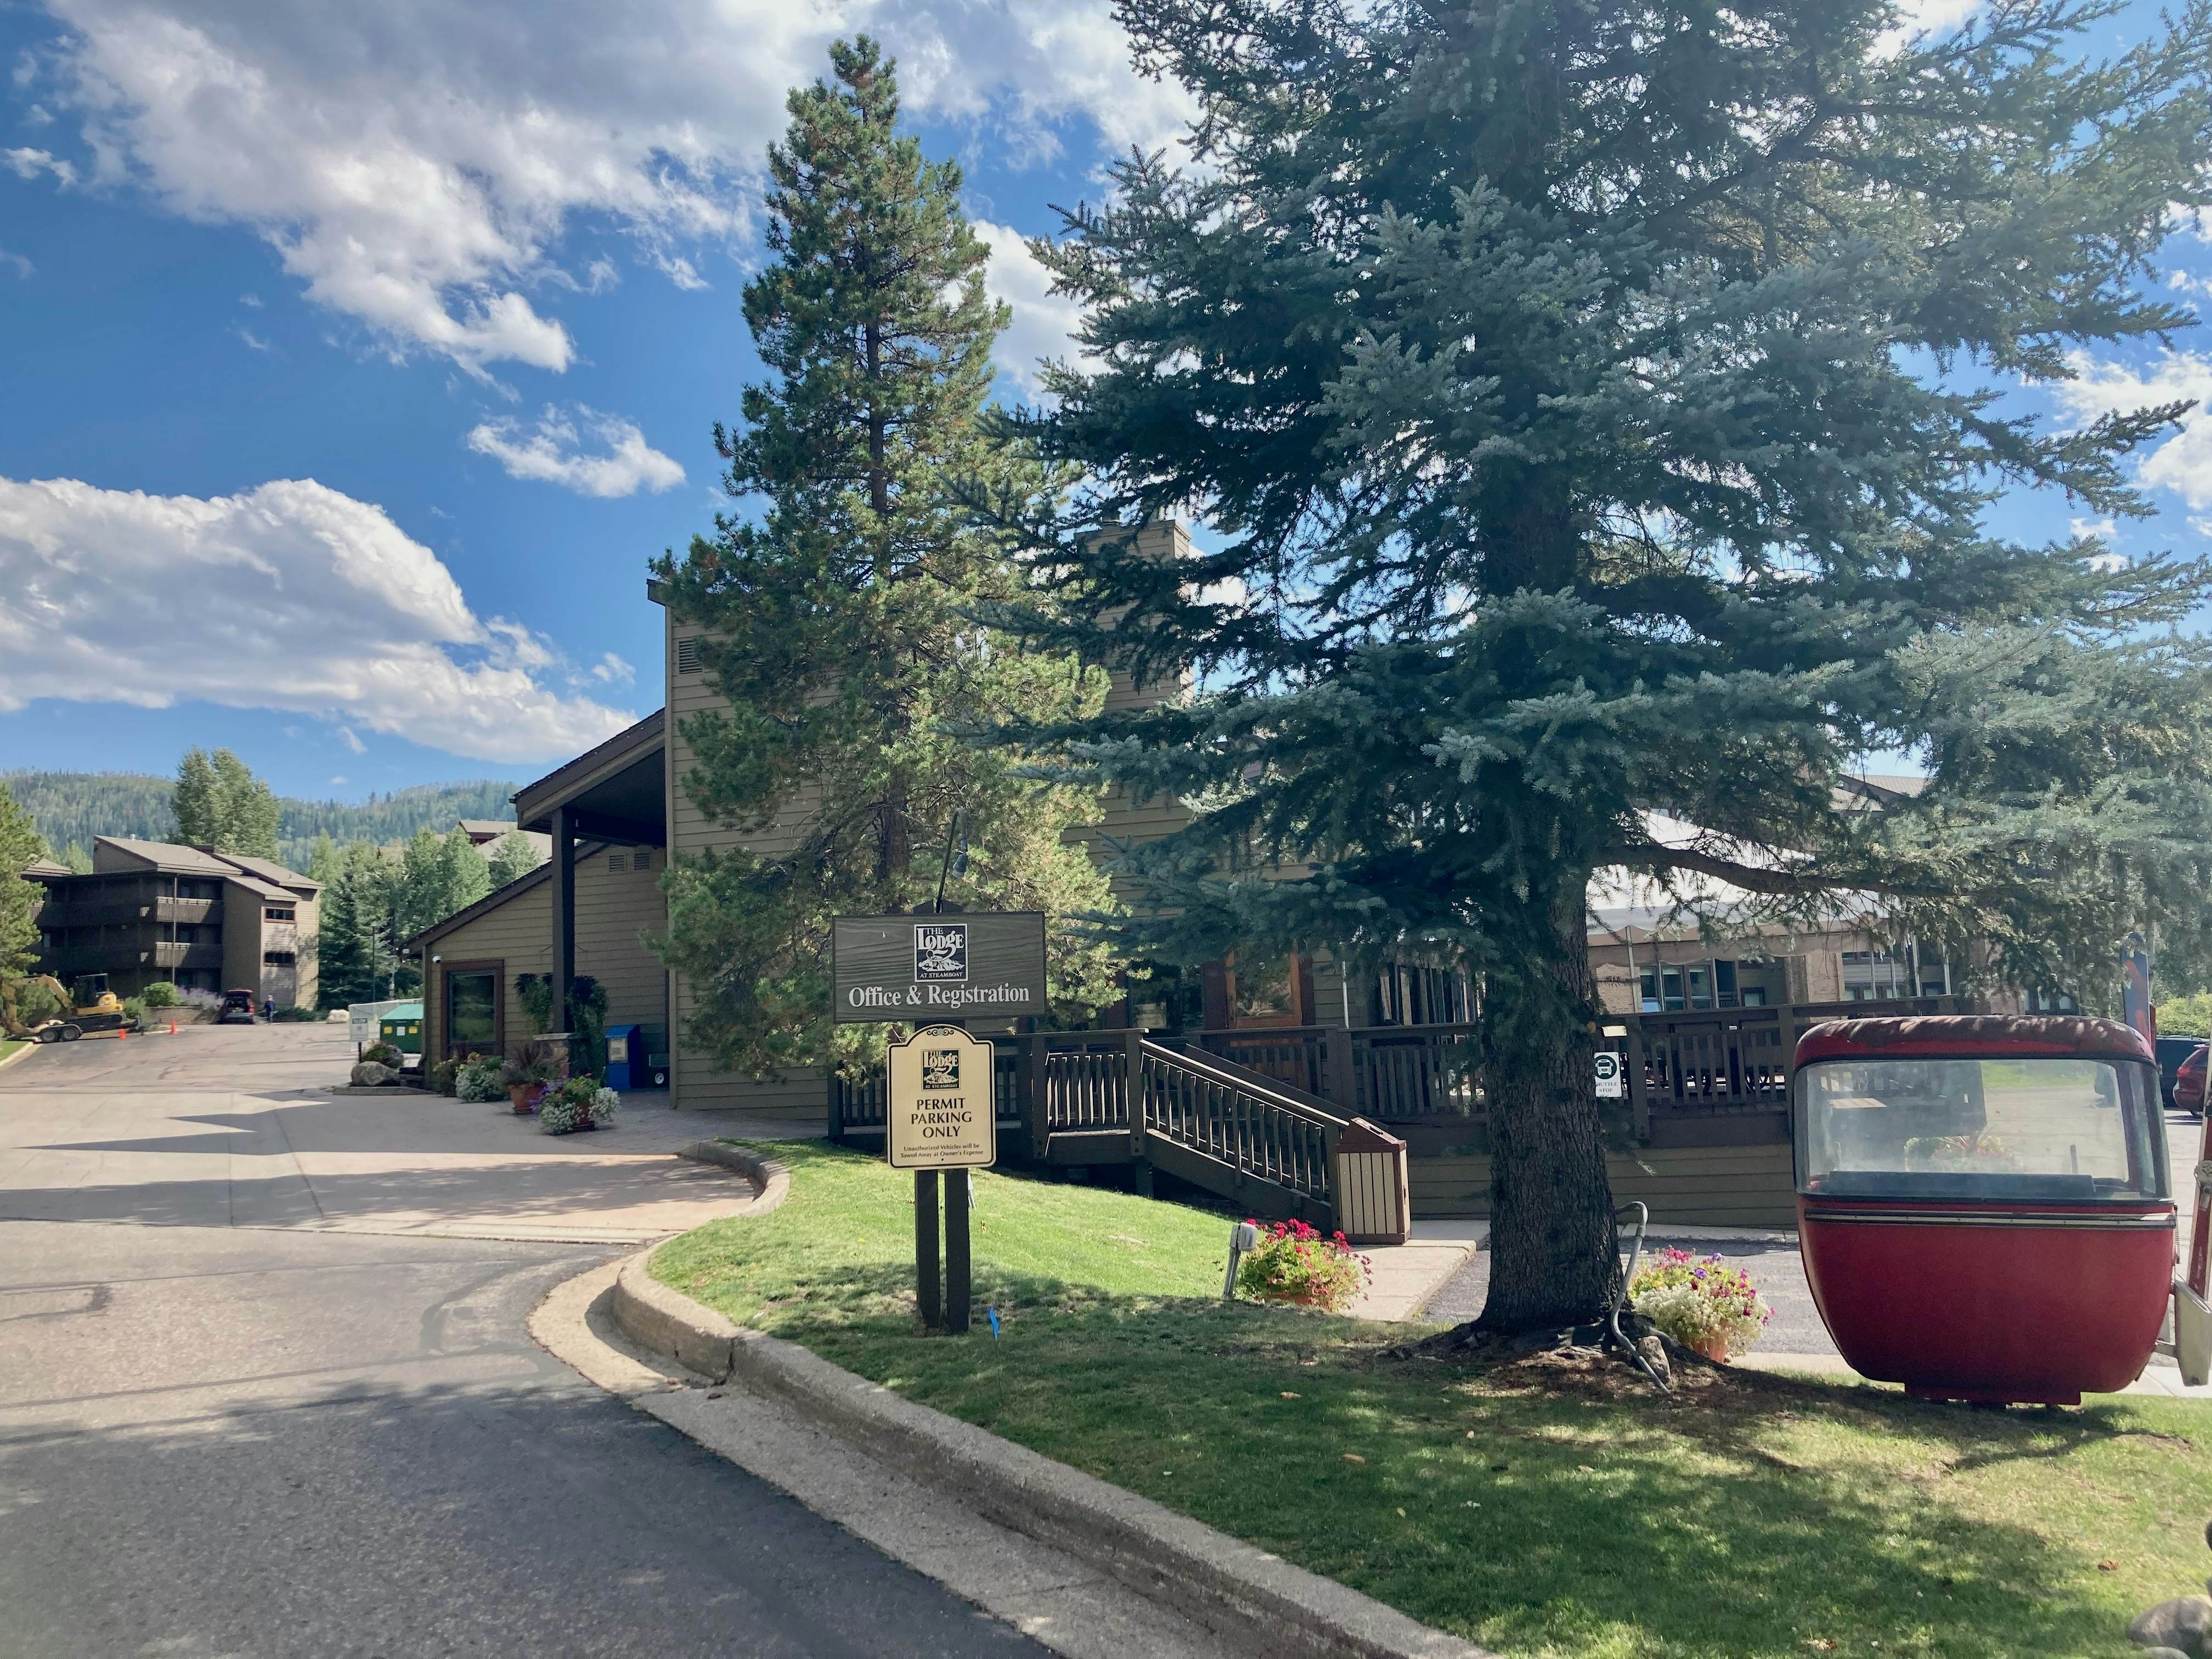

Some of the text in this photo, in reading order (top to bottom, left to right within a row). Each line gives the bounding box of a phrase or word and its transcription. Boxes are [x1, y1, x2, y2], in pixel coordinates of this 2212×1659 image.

[849, 983, 1030, 1009] Office & Registration
[917, 1097, 966, 1110] PERMIT
[911, 1111, 972, 1125] PARKING
[923, 1126, 961, 1138] ONLY
